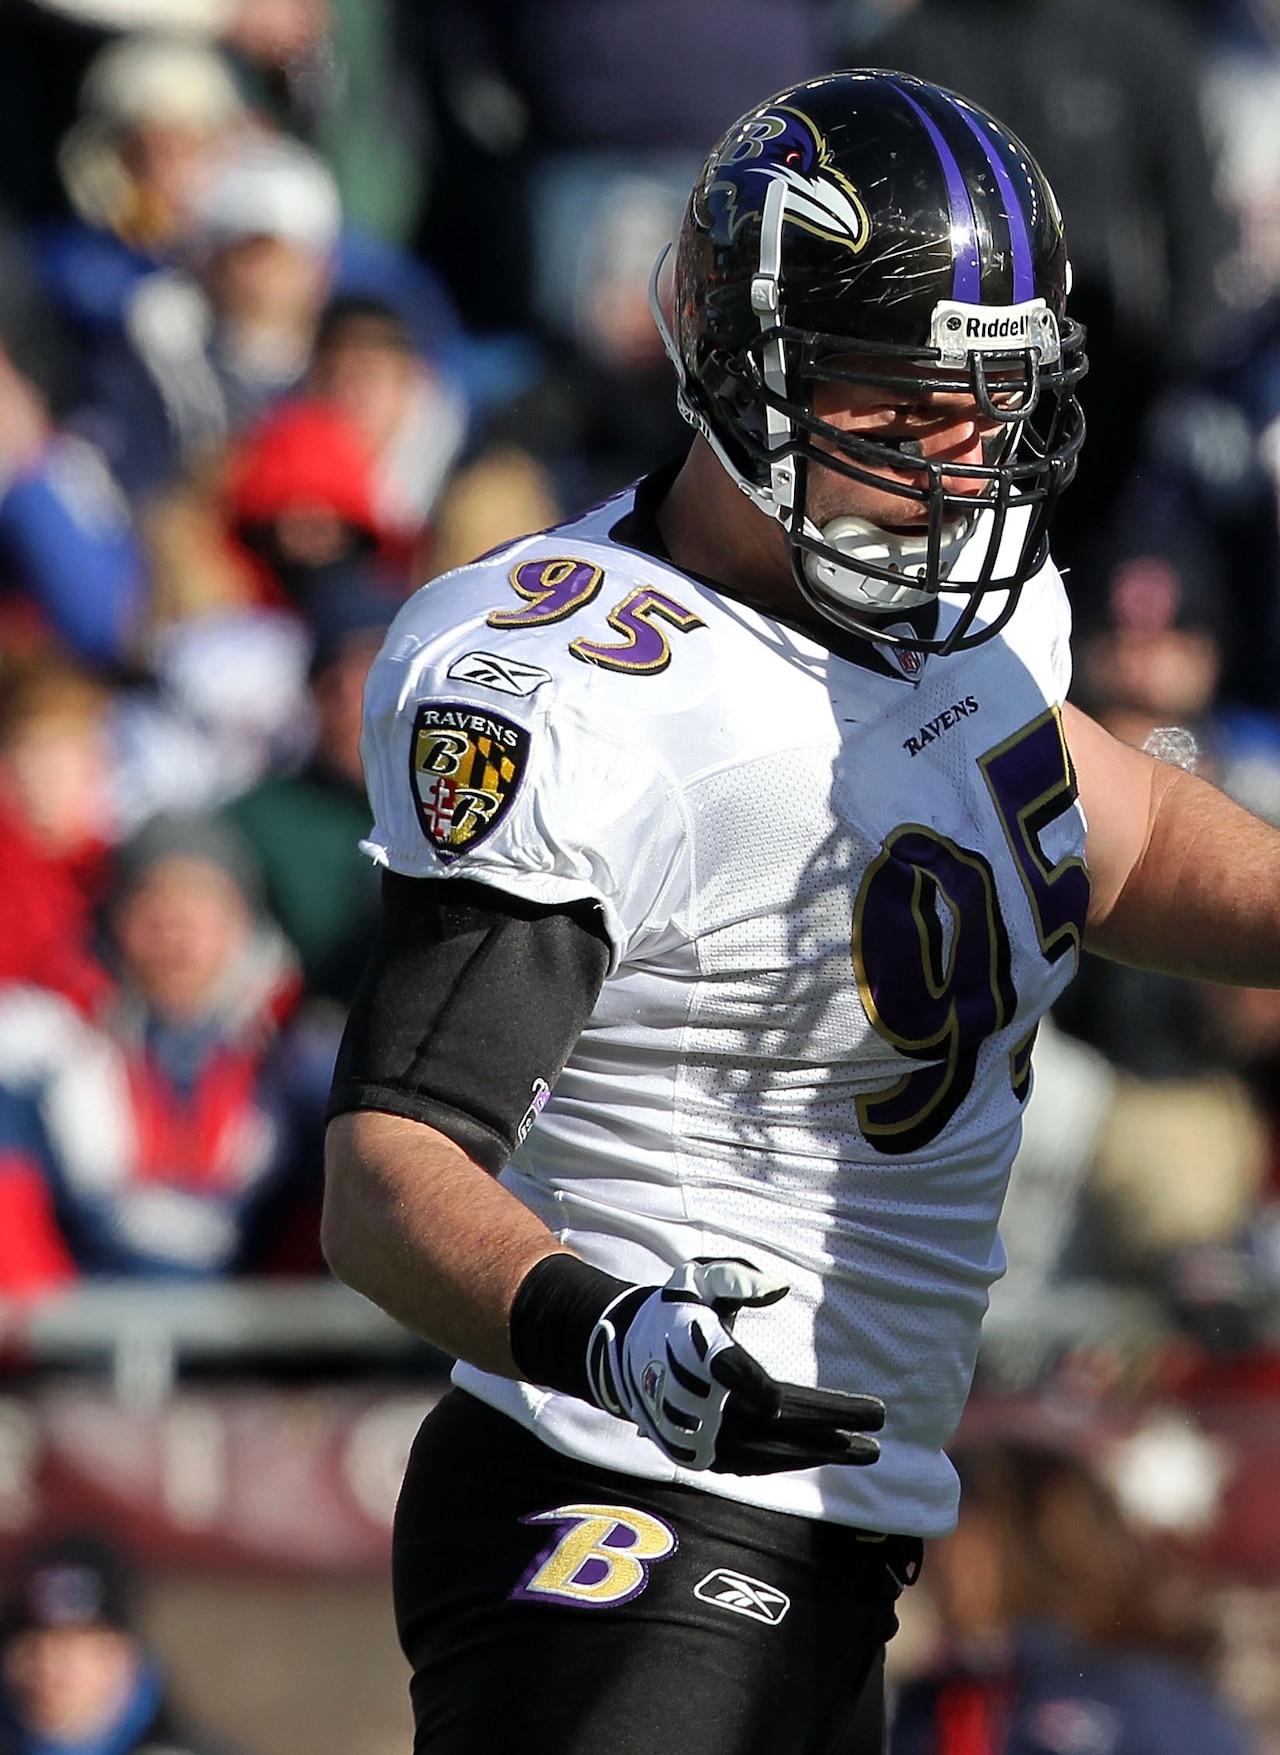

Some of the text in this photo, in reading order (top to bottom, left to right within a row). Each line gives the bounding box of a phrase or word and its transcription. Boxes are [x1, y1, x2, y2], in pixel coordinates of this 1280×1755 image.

[966, 314, 1029, 338] Riddell
[486, 556, 710, 676] 95
[424, 710, 519, 748] RAVENS
[902, 694, 980, 758] RAVENS
[851, 705, 1092, 1155] 95
[508, 1503, 680, 1608] B
